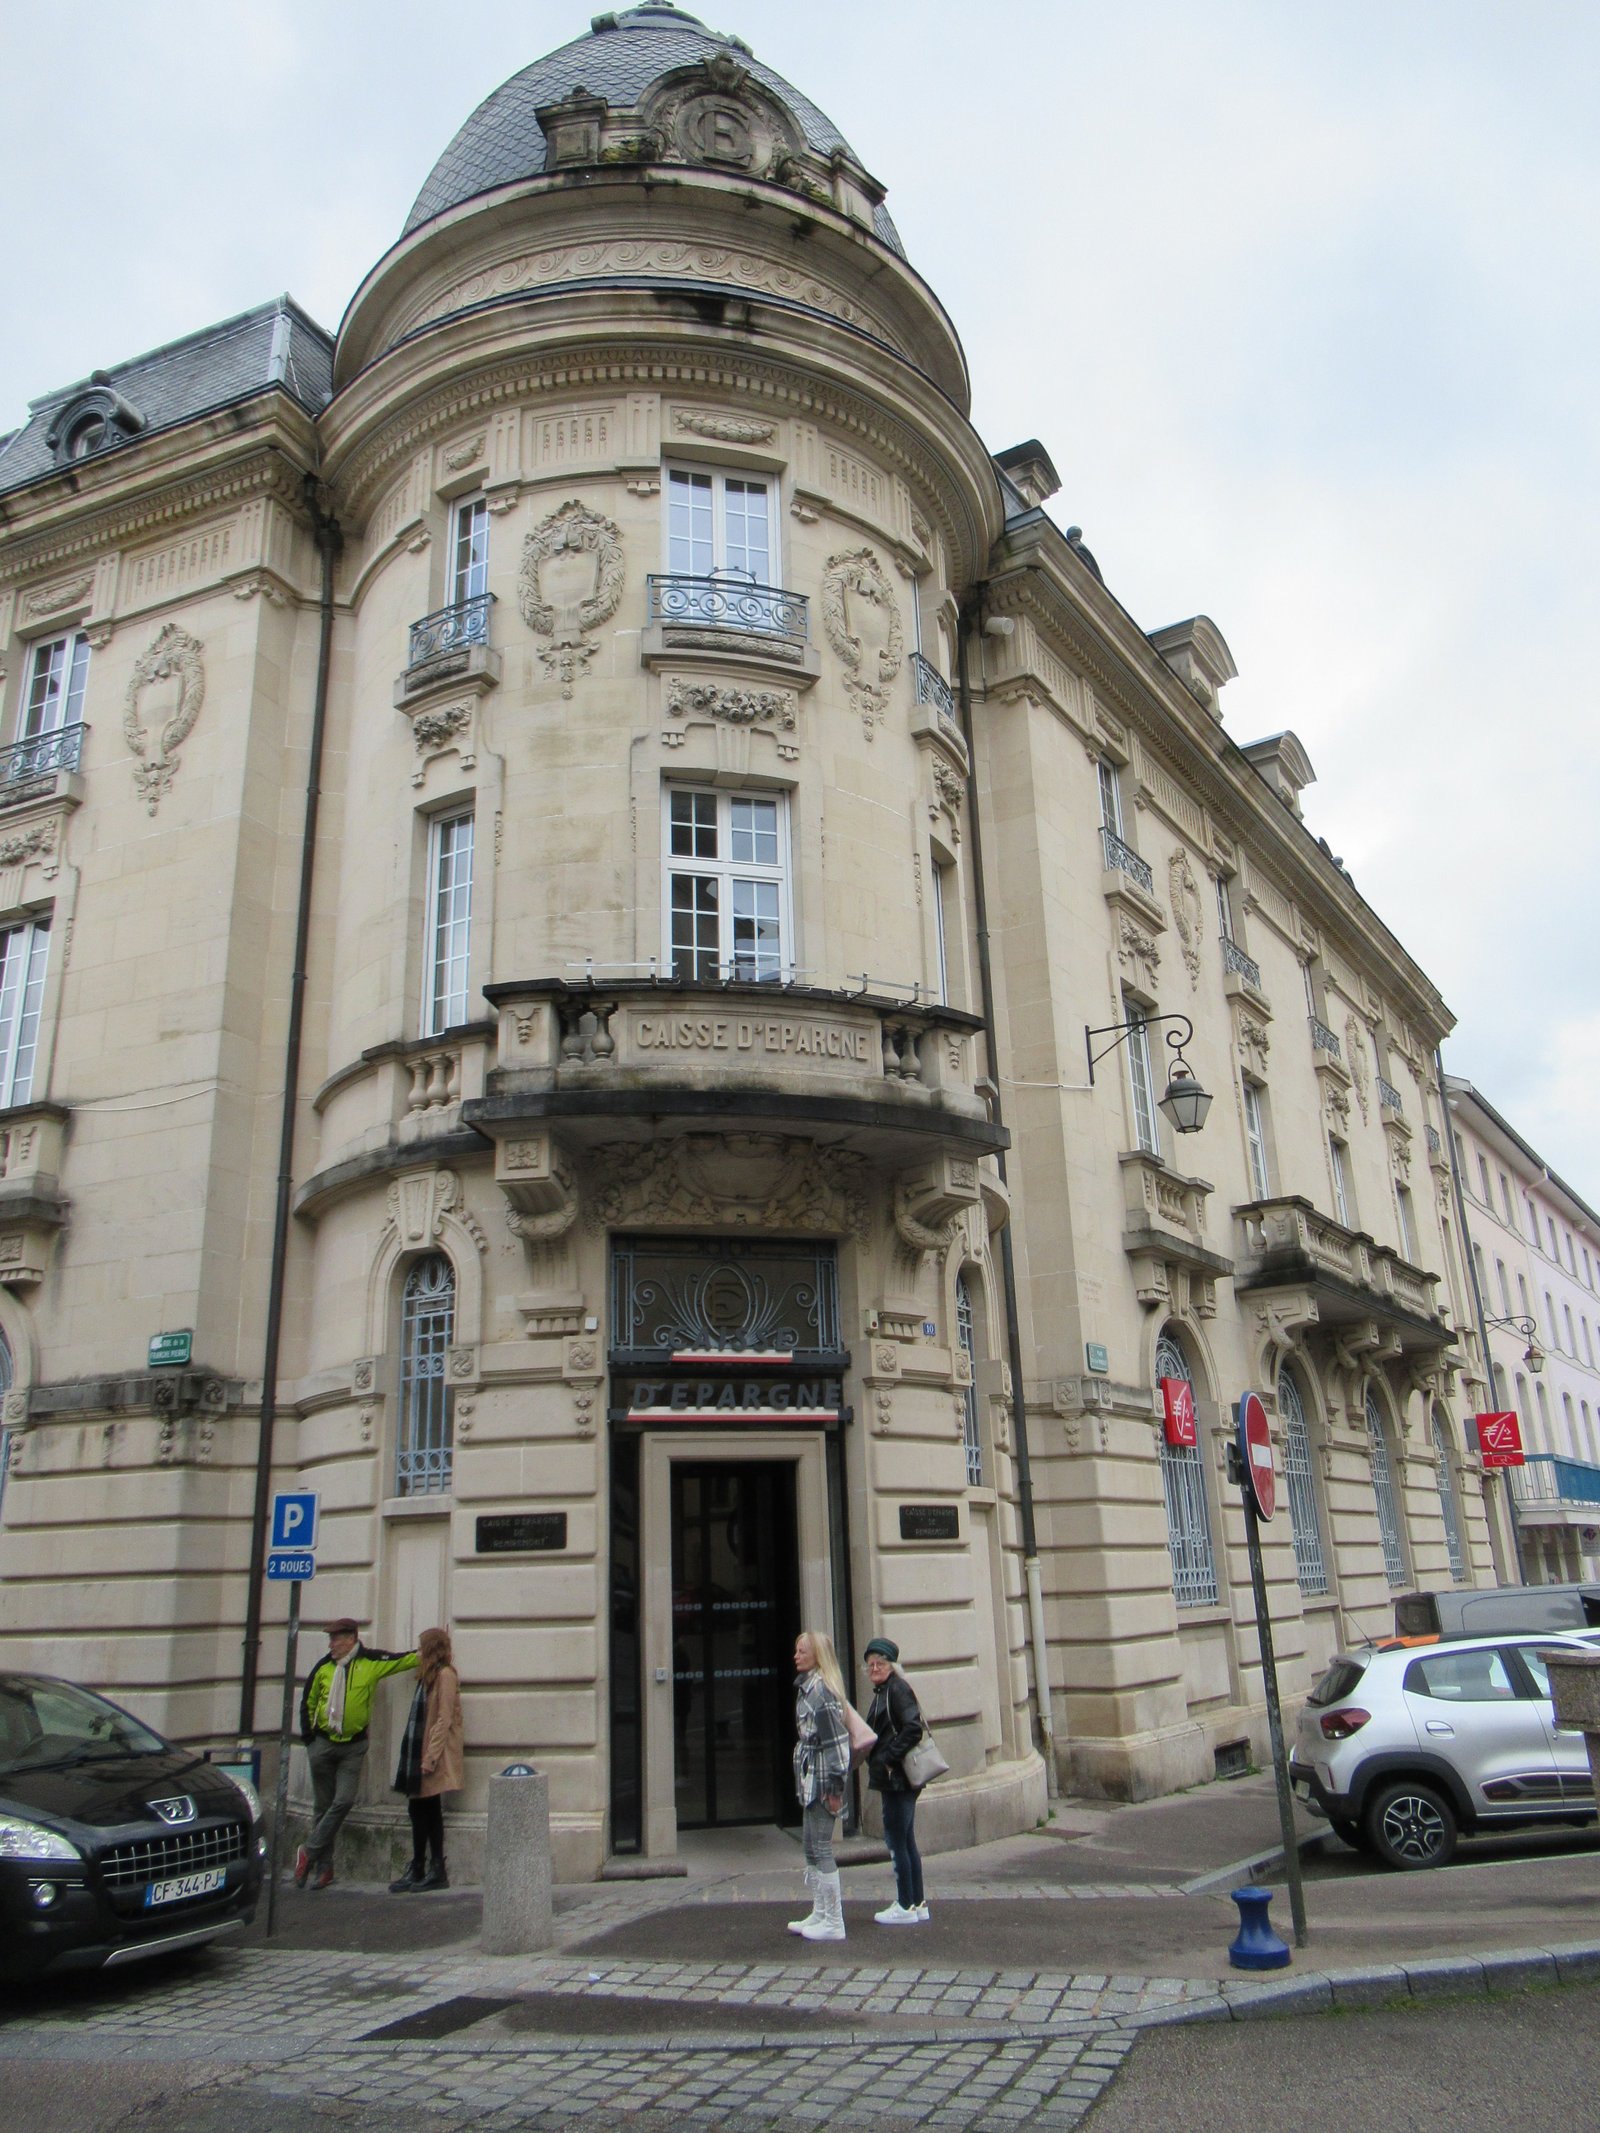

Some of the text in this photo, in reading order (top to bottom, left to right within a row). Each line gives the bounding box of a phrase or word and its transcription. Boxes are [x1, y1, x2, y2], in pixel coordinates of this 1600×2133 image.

[637, 1019, 868, 1060] CAISSE D'EPARGNE
[668, 1326, 794, 1352] CAISSE
[632, 1382, 842, 1410] D'EPARGNE
[283, 1503, 304, 1538] P
[269, 1560, 311, 1573] 2 ROUES
